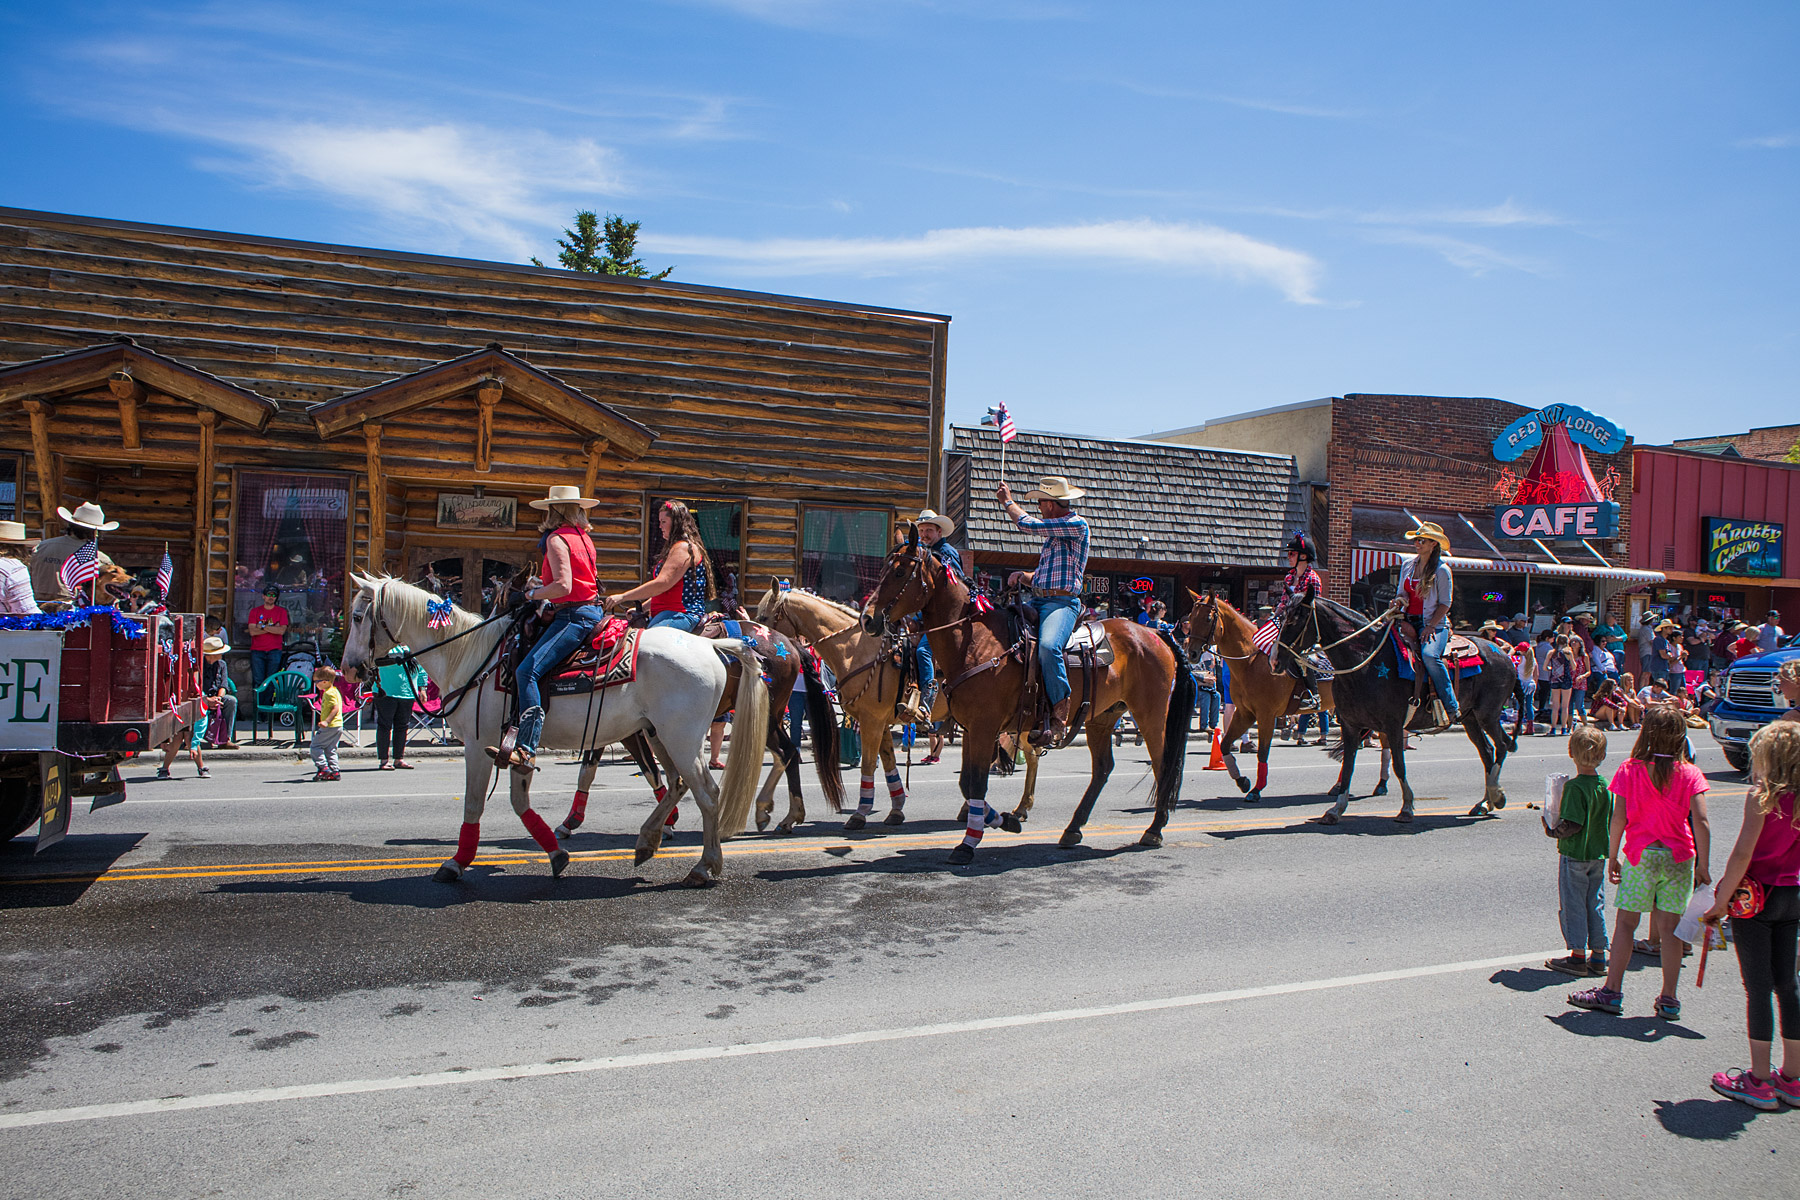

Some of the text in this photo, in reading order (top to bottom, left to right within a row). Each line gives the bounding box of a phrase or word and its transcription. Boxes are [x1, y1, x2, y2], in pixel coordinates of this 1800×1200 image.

[1507, 415, 1611, 447] RED LODGE
[1500, 505, 1598, 536] CAFE
[1711, 523, 1782, 552] Knotty
[1131, 579, 1154, 592] OPEN
[1708, 594, 1726, 602] OPEN
